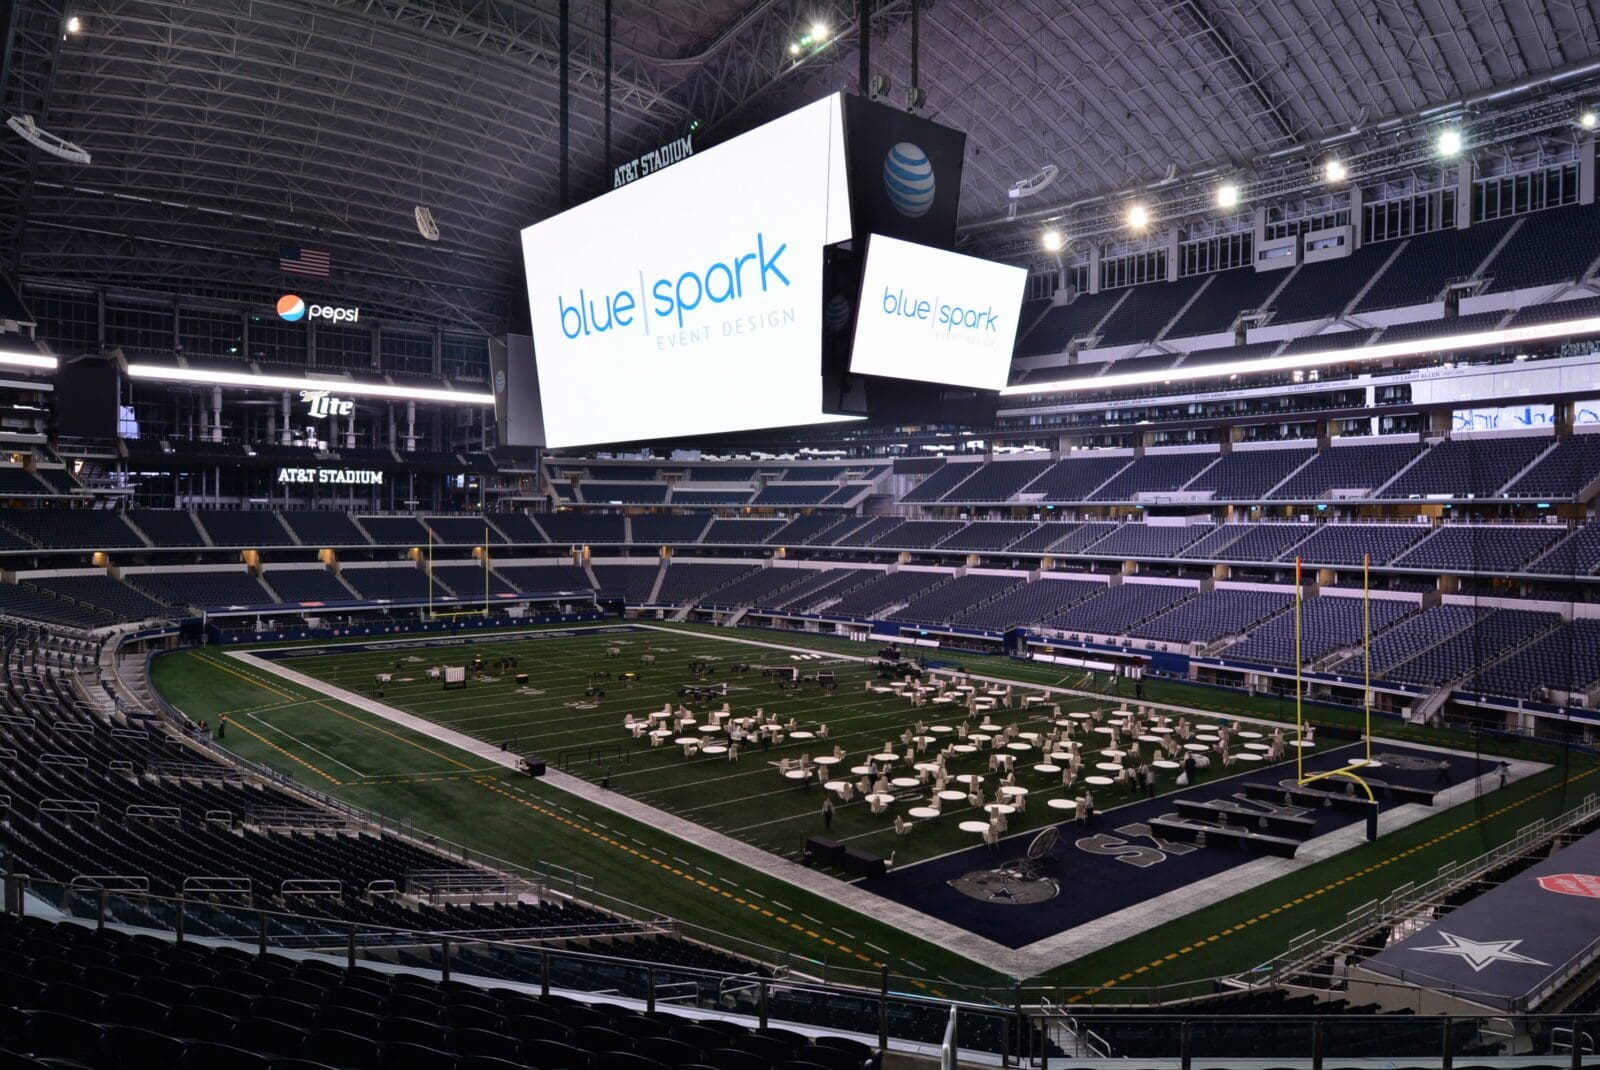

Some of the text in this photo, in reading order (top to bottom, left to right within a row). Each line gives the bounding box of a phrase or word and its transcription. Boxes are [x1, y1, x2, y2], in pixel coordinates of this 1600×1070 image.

[614, 134, 693, 188] AT&T STADIUM
[558, 232, 790, 340] blue spark
[308, 304, 359, 324] pepsi
[657, 307, 796, 351] EVENT DESIGN
[883, 286, 999, 332] blue spark
[307, 392, 354, 418] Lite
[278, 468, 383, 484] AT&T STADIUM
